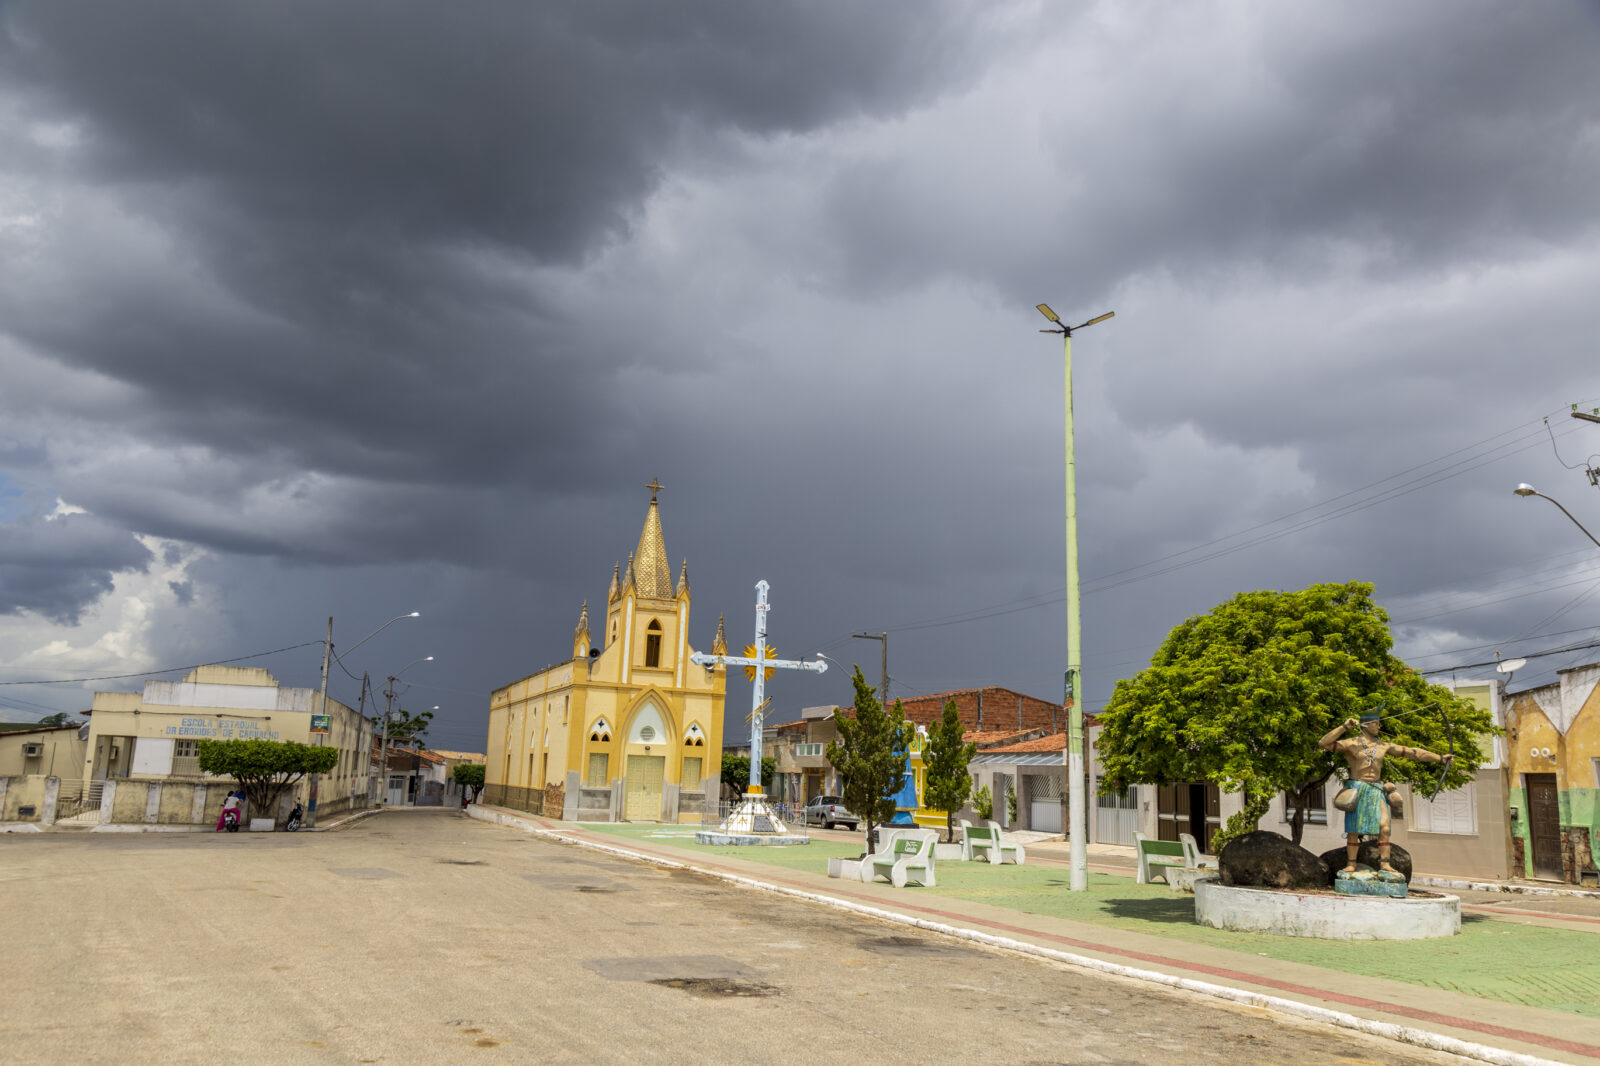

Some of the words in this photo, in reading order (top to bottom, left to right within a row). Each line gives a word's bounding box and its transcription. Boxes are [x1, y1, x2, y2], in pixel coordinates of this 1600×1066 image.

[181, 718, 213, 727] ESCOLA
[219, 720, 259, 730] ESTADUAL
[222, 729, 233, 738] DE
[238, 730, 280, 740] CARVALHO
